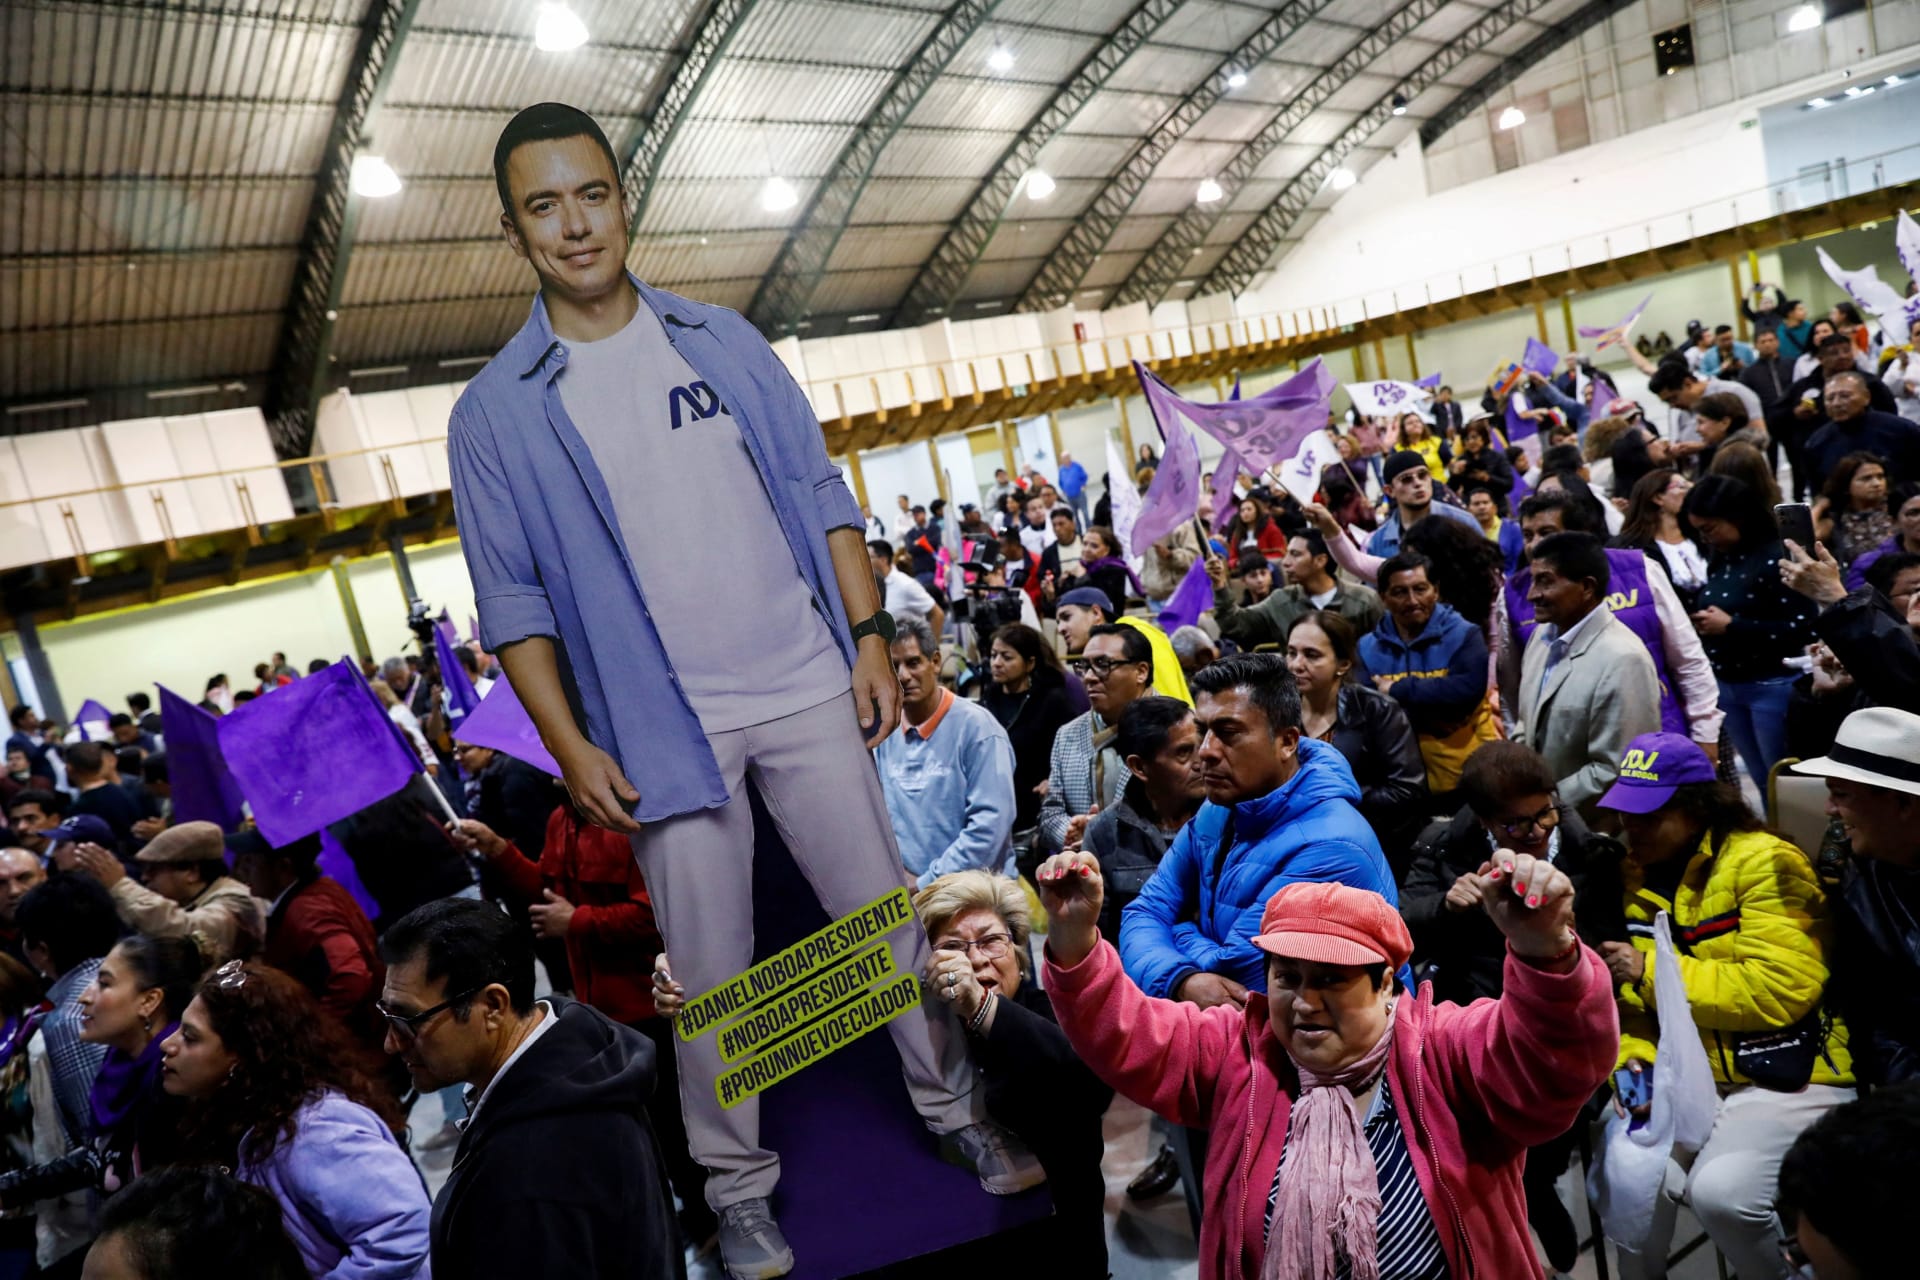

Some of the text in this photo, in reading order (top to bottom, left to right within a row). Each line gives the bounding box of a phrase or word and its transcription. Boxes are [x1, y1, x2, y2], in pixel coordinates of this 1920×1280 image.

[681, 892, 909, 1036] #DANIELNOBOAPRESIDENTE
[722, 946, 892, 1058] #NOBOAPRESIDENTE
[720, 978, 918, 1104] #PORUNNUEVOECUADOR
